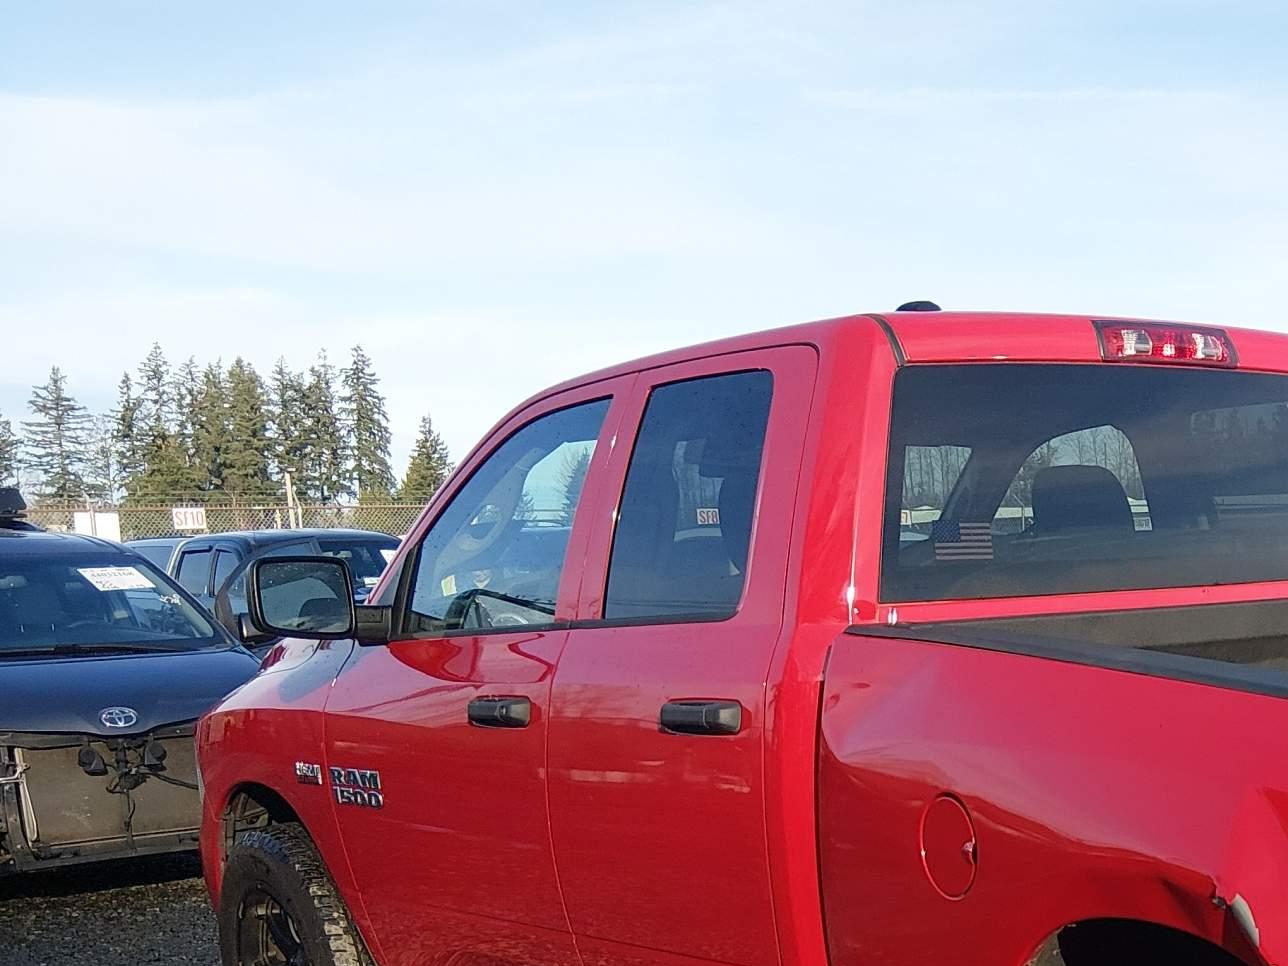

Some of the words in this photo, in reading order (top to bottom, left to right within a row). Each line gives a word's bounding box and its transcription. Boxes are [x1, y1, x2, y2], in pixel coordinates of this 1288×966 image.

[174, 510, 204, 527] SF10
[330, 767, 381, 790] RAM
[332, 786, 385, 809] 1500
